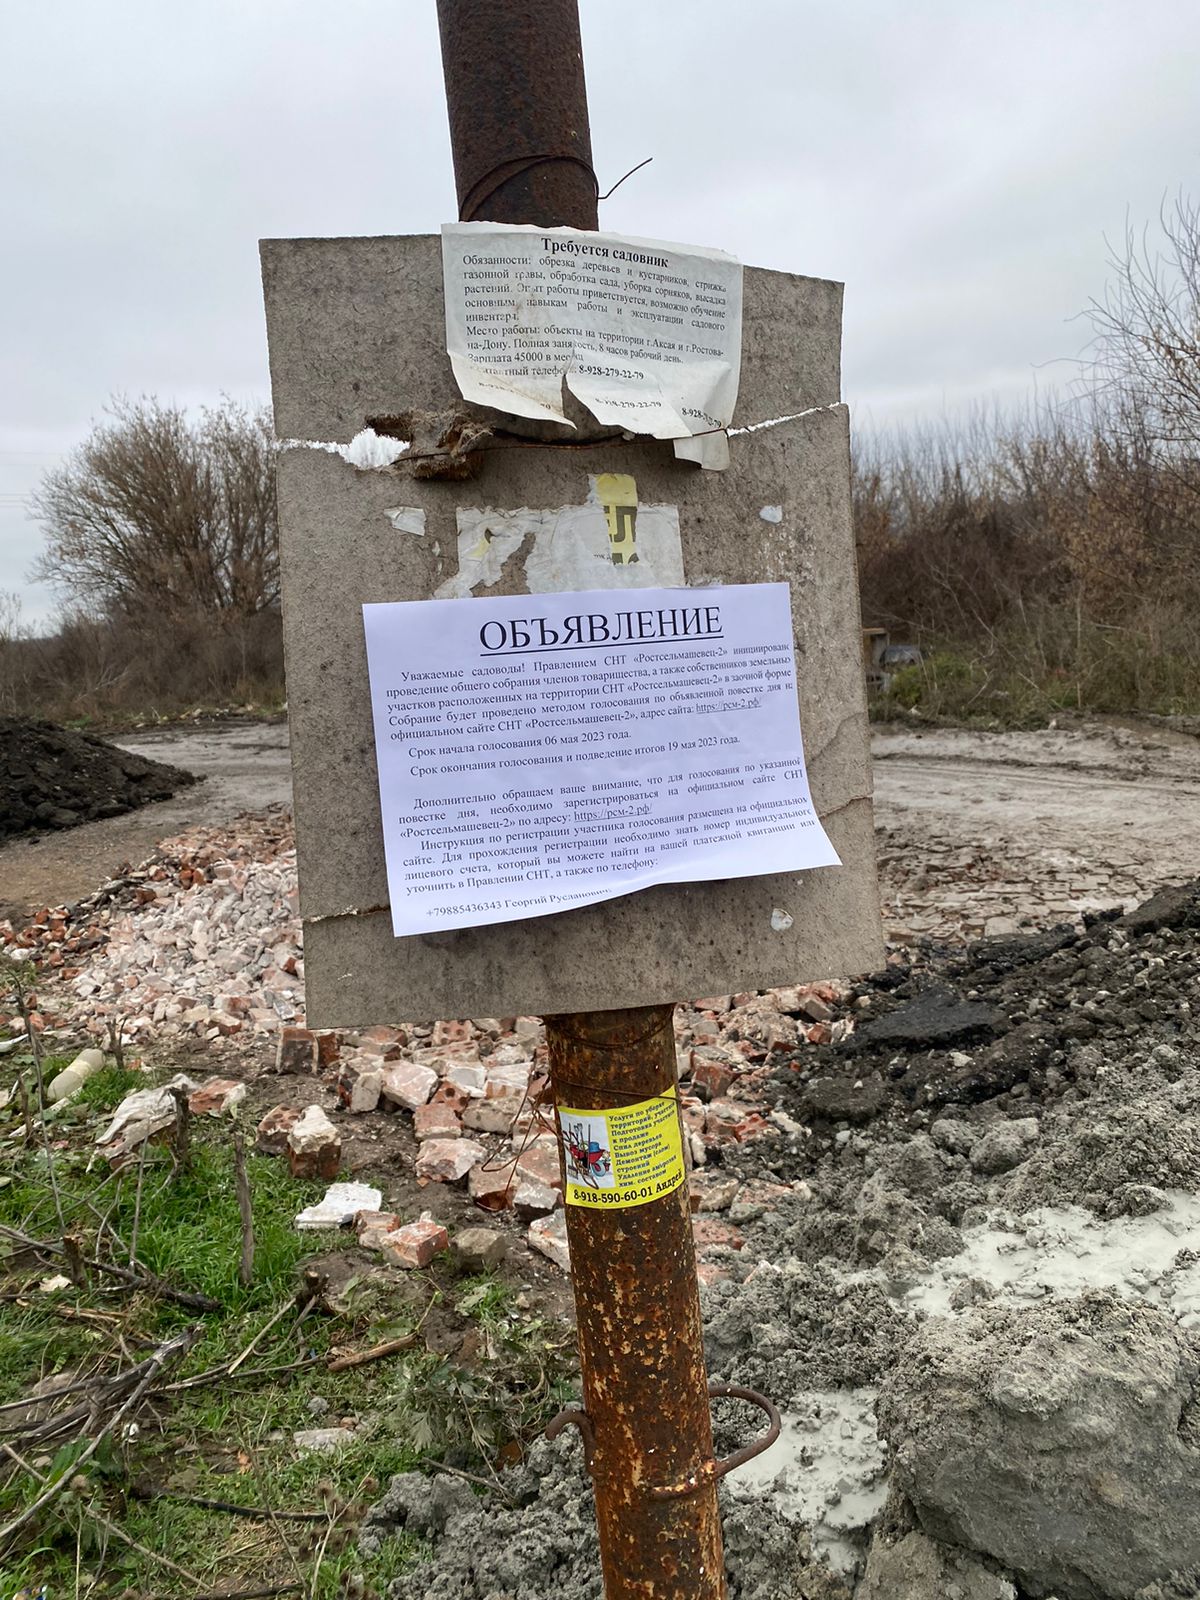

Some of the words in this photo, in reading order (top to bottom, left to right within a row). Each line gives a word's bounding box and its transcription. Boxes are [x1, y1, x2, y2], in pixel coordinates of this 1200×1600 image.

[541, 237, 609, 257] Требуется
[612, 249, 669, 268] садовник
[463, 255, 531, 266] Обязанности:
[539, 256, 576, 268] обрезка
[582, 261, 621, 274] деревьев
[639, 270, 690, 287] кустарников,
[463, 269, 509, 280] газонной
[550, 271, 597, 284] обработка
[600, 277, 621, 288] сада,
[624, 280, 652, 293] уборка
[695, 294, 726, 306] высадка
[546, 284, 579, 296] работы
[582, 288, 648, 307] приветствуется,
[650, 299, 689, 312] возможно
[691, 305, 726, 318] обучение
[577, 301, 608, 313] работы
[631, 309, 684, 325] эксплуатации
[691, 319, 725, 331] садового
[466, 326, 498, 336] Место
[502, 325, 540, 337] работы:
[544, 324, 583, 336] объекты
[585, 330, 596, 338] на
[598, 331, 645, 346] территории
[647, 338, 676, 350] г.Аксая
[513, 338, 550, 349] Полная
[606, 346, 629, 356] часов
[630, 349, 662, 361] рабочий
[514, 351, 543, 362] 45000
[578, 365, 645, 380] 8-928-279-22-79
[480, 606, 723, 651] ОБЪЯВЛЕНИЕ
[386, 685, 449, 699] проведение
[451, 681, 490, 693] общего
[492, 678, 541, 691] собрания
[543, 675, 580, 685] членов
[582, 668, 651, 683] товарищества,
[660, 666, 685, 676] также
[686, 661, 748, 673] собственников
[401, 669, 464, 682] Уважаемые
[471, 663, 526, 677] садоводы!
[533, 659, 597, 673] Правлением
[604, 655, 627, 667] СНТ
[633, 647, 728, 664] «Ростсельмашевец-2»
[387, 701, 436, 715] участков
[438, 693, 523, 710] расположенных
[525, 693, 538, 701] на
[540, 687, 600, 701] территории
[602, 683, 625, 694] СНТ
[627, 674, 723, 692] «Ростсельмашевец-2»
[731, 669, 763, 682] заочной
[764, 668, 792, 681] форме
[389, 714, 442, 727] Собрание
[446, 711, 477, 724] будет
[481, 707, 537, 721] проведено
[541, 702, 586, 714] методом
[590, 696, 650, 710] голосования
[654, 695, 666, 703] по
[669, 687, 725, 701] объявленной
[727, 685, 764, 696] повестке
[767, 682, 781, 692] дня
[390, 727, 464, 742] официальном
[466, 724, 496, 734] сайте
[497, 720, 523, 731] СНТ
[525, 710, 638, 729] «Ростсельмашевец-2»,
[640, 708, 666, 720] адрес
[667, 706, 694, 716] сайта:
[408, 747, 436, 759] Срок
[439, 744, 475, 756] начала
[477, 738, 542, 752] голосования
[544, 736, 558, 746] 06
[560, 736, 579, 745] мая
[581, 731, 605, 743] 2023
[607, 730, 632, 741] года.
[410, 766, 438, 778] Срок
[440, 761, 497, 774] окончания
[499, 754, 563, 768] голосования
[566, 754, 573, 762] и
[575, 748, 632, 762] подведение
[634, 745, 666, 756] итогов
[668, 741, 679, 751] 19
[680, 741, 697, 750] мая
[698, 737, 718, 748] 2023
[720, 736, 741, 745] года.
[398, 812, 447, 825] повестке
[490, 802, 553, 816] необходимо
[563, 790, 659, 810] зарегистрироваться
[668, 788, 679, 796] на
[687, 779, 745, 795] официальном
[752, 774, 776, 785] сайте
[413, 793, 497, 810] Дополнительно
[502, 787, 554, 802] обращаем
[560, 785, 586, 794] ваше
[592, 779, 642, 792] внимание,
[647, 776, 663, 785] что
[667, 774, 683, 784] для
[688, 766, 740, 781] голосования
[744, 763, 755, 772] по
[400, 817, 516, 839] «Ростсельмашевец-2»
[518, 818, 531, 827] по
[533, 814, 571, 826] адресу:
[402, 856, 436, 867] сайте.
[441, 852, 462, 864] Для
[469, 845, 538, 861] прохождения
[544, 837, 608, 854] регистрации
[614, 830, 670, 844] необходимо
[675, 825, 699, 835] знать
[703, 820, 730, 831] номер
[420, 836, 485, 851] Инструкция
[489, 835, 502, 844] по
[505, 829, 570, 845] регистрации
[574, 822, 625, 837] участника
[628, 813, 685, 829] голосования
[687, 806, 734, 823] размещена
[736, 805, 747, 813] на
[404, 869, 454, 881] лицевого
[459, 864, 491, 874] счета,
[497, 856, 541, 871] который
[547, 856, 561, 865] вы
[567, 851, 605, 863] можете
[610, 846, 639, 858] найти
[644, 845, 655, 853] на
[660, 837, 688, 851] вашей
[692, 832, 742, 847] платежной
[747, 823, 796, 839] квитанции
[406, 881, 456, 897] уточнить
[466, 874, 524, 889] Правлении
[526, 869, 554, 881] СНТ,
[564, 865, 593, 877] также
[596, 864, 609, 873] по
[611, 858, 658, 872] телефону:
[426, 899, 502, 917] +79885436343
[504, 894, 548, 910] Георгий
[608, 1114, 634, 1122] Услуги
[573, 1186, 653, 1204] 8-918-590-60-01
[656, 1168, 683, 1193] Андрей
